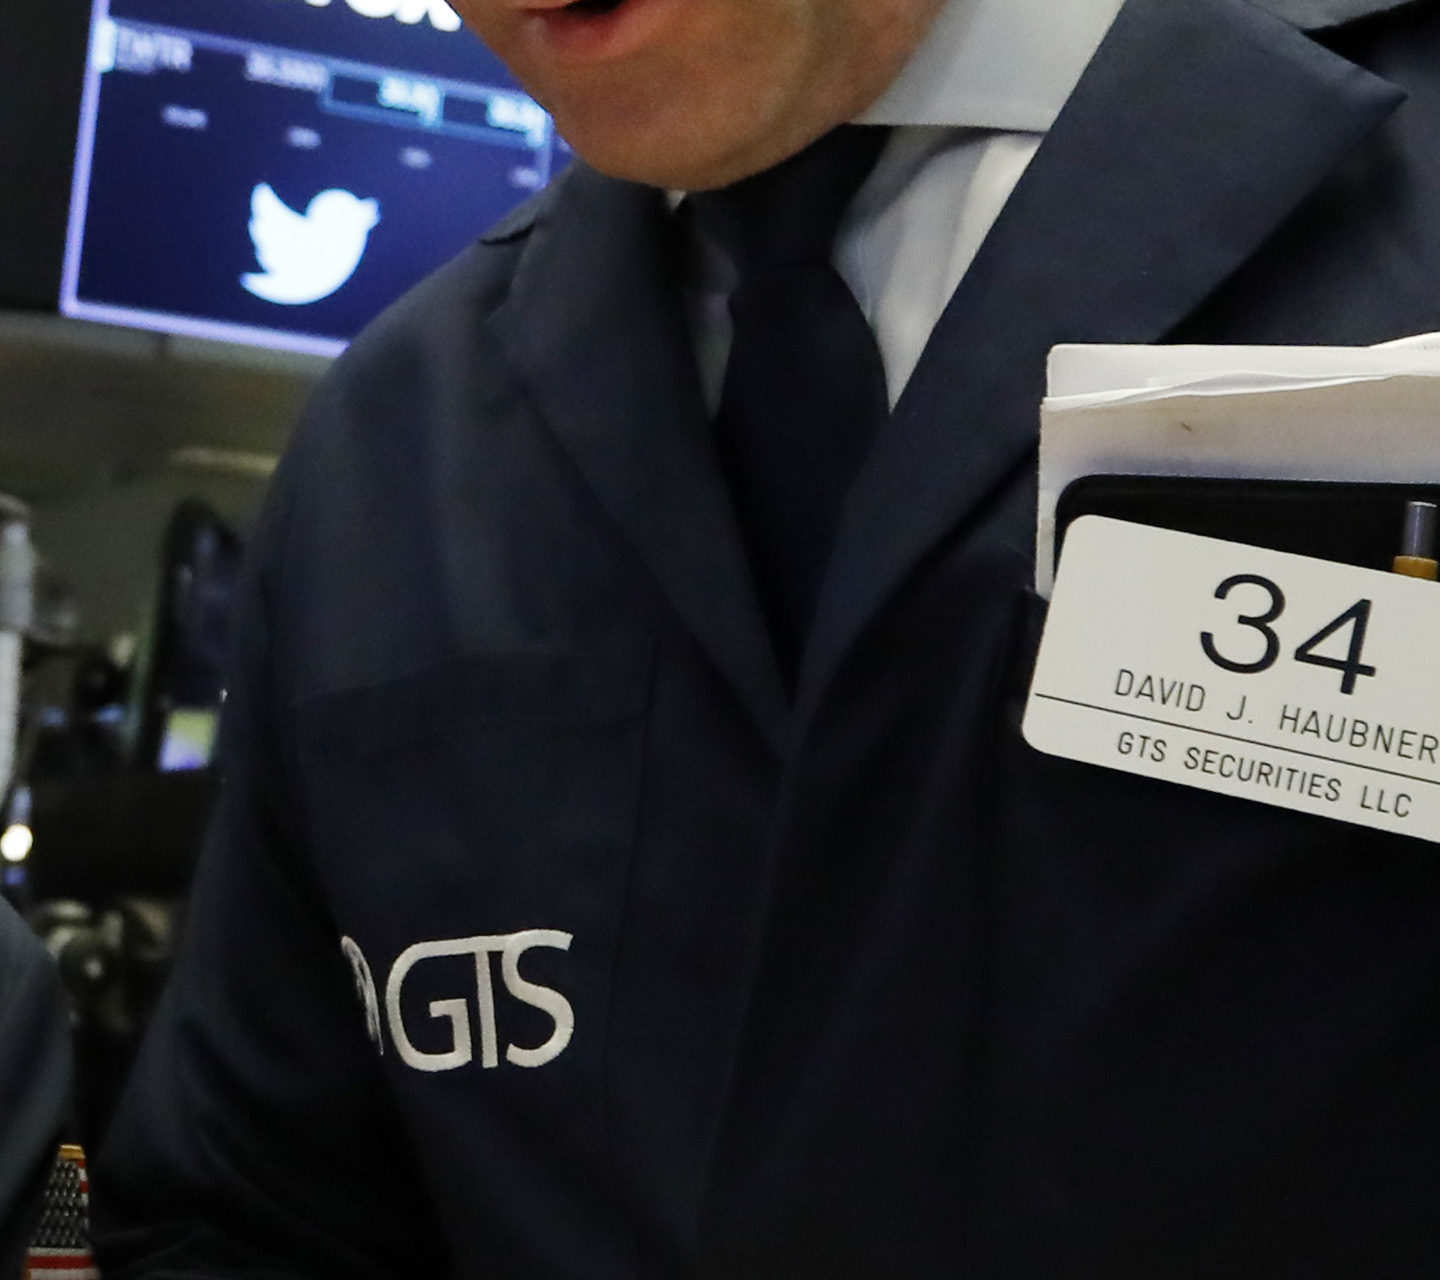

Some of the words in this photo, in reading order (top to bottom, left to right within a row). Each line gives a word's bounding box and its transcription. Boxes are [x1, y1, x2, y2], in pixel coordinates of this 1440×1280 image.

[1200, 573, 1376, 695] 34
[1114, 668, 1207, 712] DAVID
[1225, 695, 1254, 725] J.
[1278, 704, 1440, 765] HAUBNER
[1117, 730, 1169, 764] GTS
[1183, 746, 1343, 803] SECURITIES
[1359, 784, 1413, 819] LLC
[385, 929, 575, 1073] GTS
